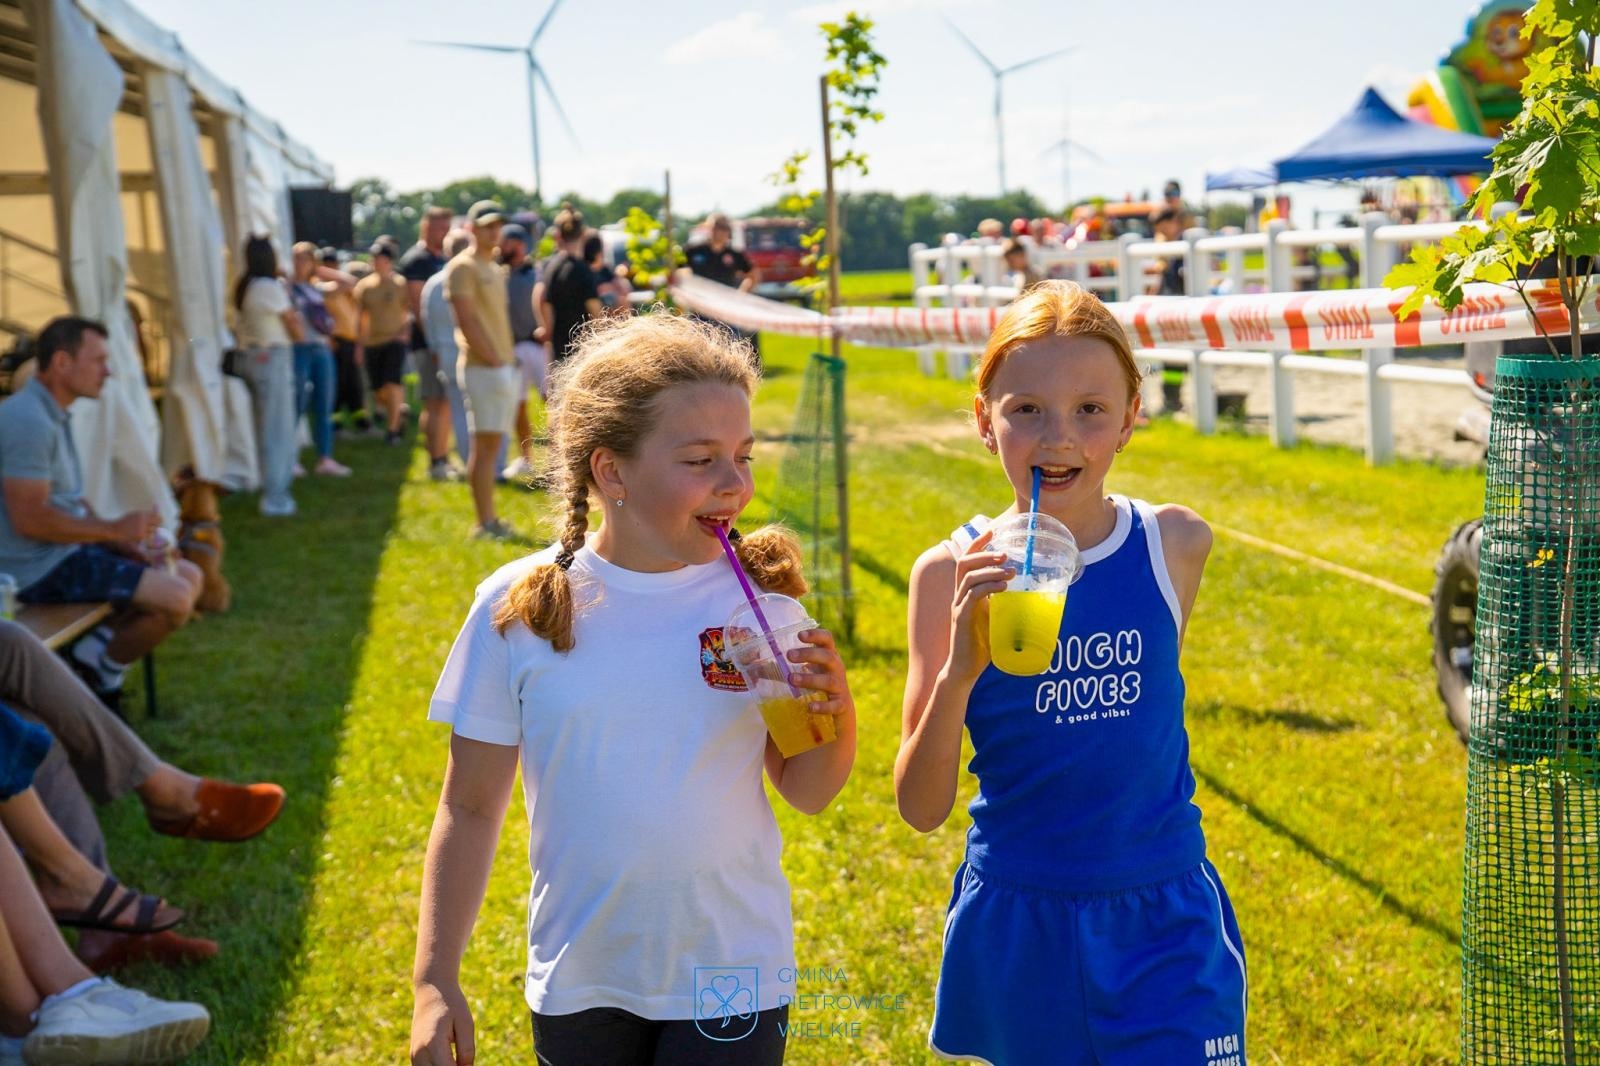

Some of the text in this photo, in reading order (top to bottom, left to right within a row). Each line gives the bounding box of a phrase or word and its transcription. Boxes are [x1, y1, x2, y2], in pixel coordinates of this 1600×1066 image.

[1036, 671, 1141, 713] FIVES
[1055, 708, 1131, 724] & good vibes
[1204, 1033, 1239, 1058] HIGH
